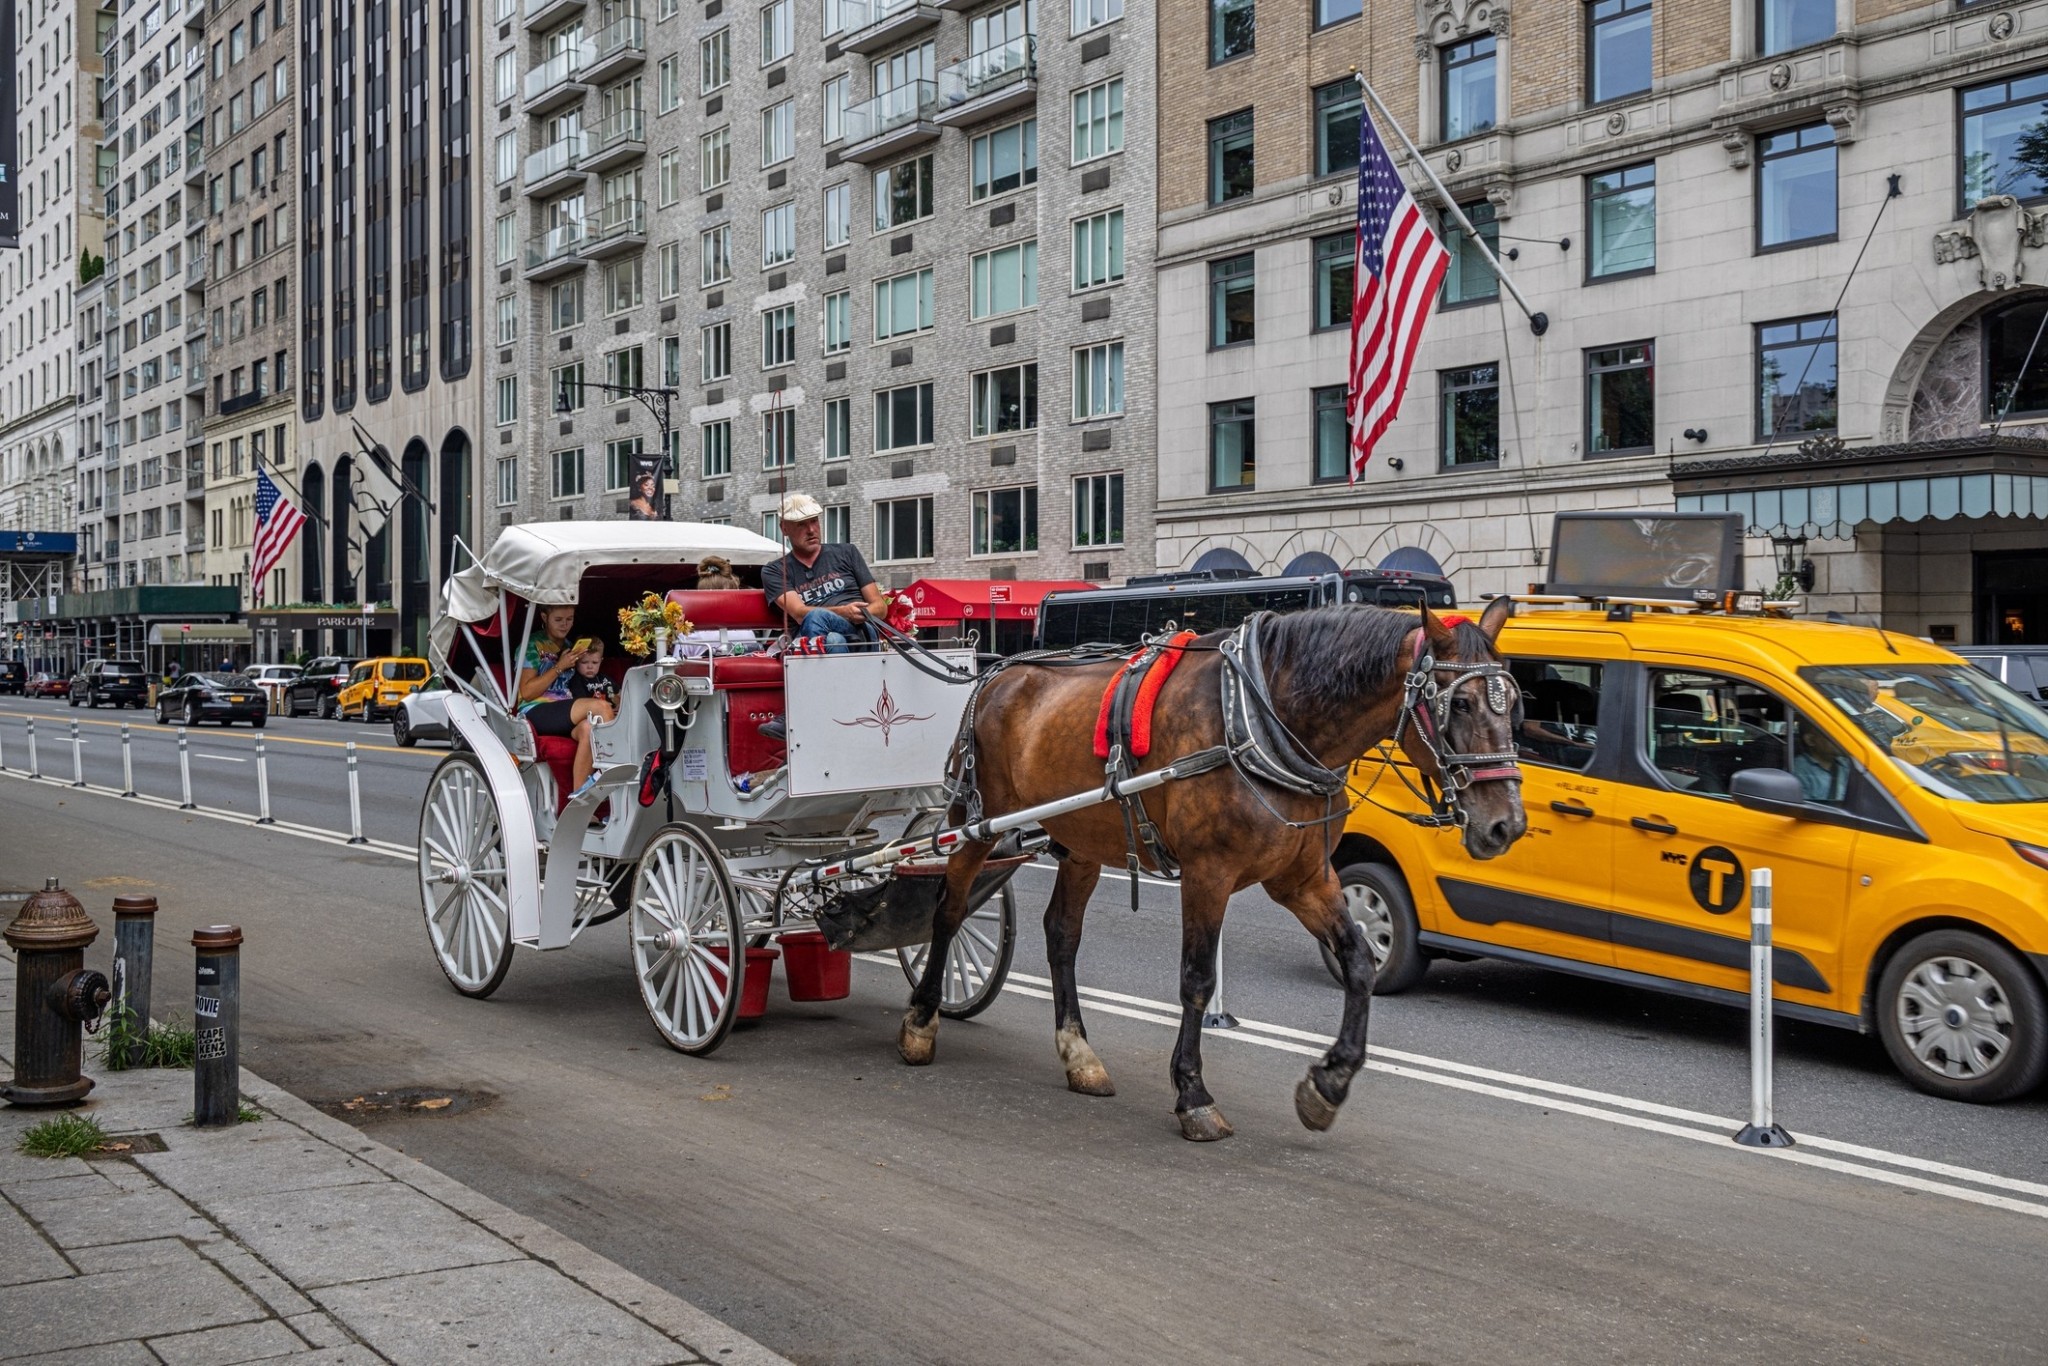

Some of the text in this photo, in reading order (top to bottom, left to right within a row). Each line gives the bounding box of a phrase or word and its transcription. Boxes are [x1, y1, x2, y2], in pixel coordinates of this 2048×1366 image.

[317, 617, 375, 626] PARK LANE
[1661, 851, 1687, 866] NYC
[1700, 858, 1735, 906] T
[199, 1042, 225, 1054] KENZ
